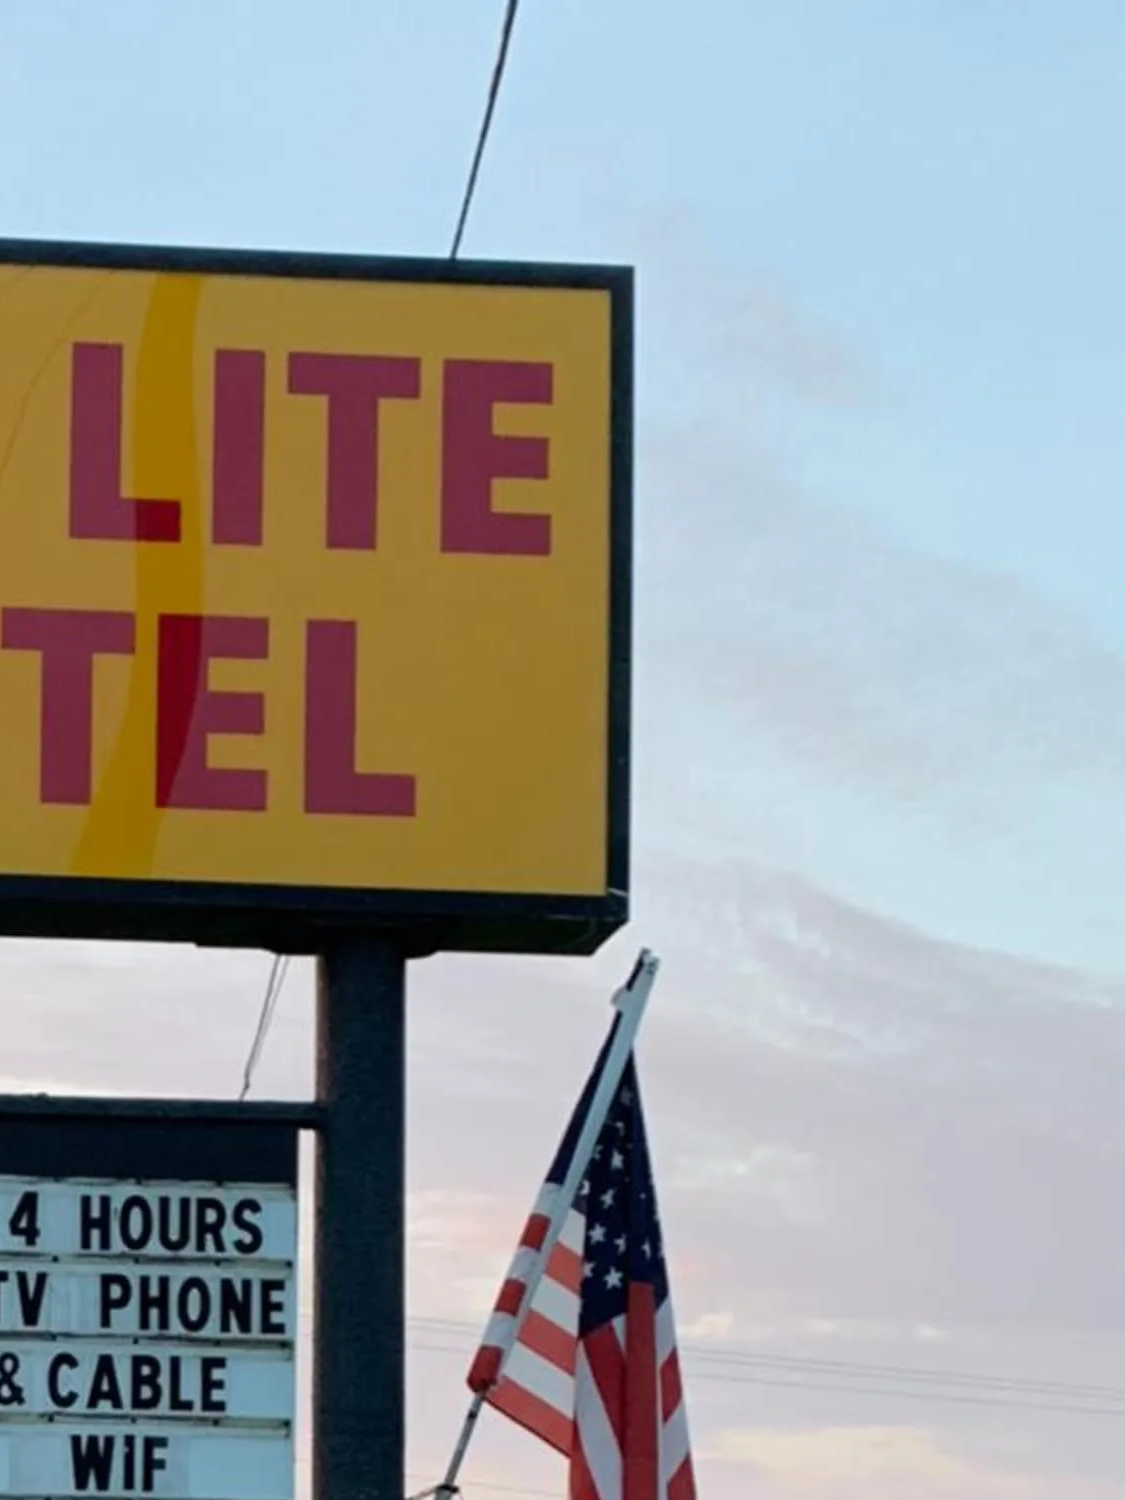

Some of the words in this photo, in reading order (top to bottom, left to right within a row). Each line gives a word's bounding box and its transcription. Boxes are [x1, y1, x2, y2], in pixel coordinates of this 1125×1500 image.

[69, 341, 555, 557] LITE
[80, 1195, 264, 1254] HOURS
[99, 1273, 287, 1334] PHONE
